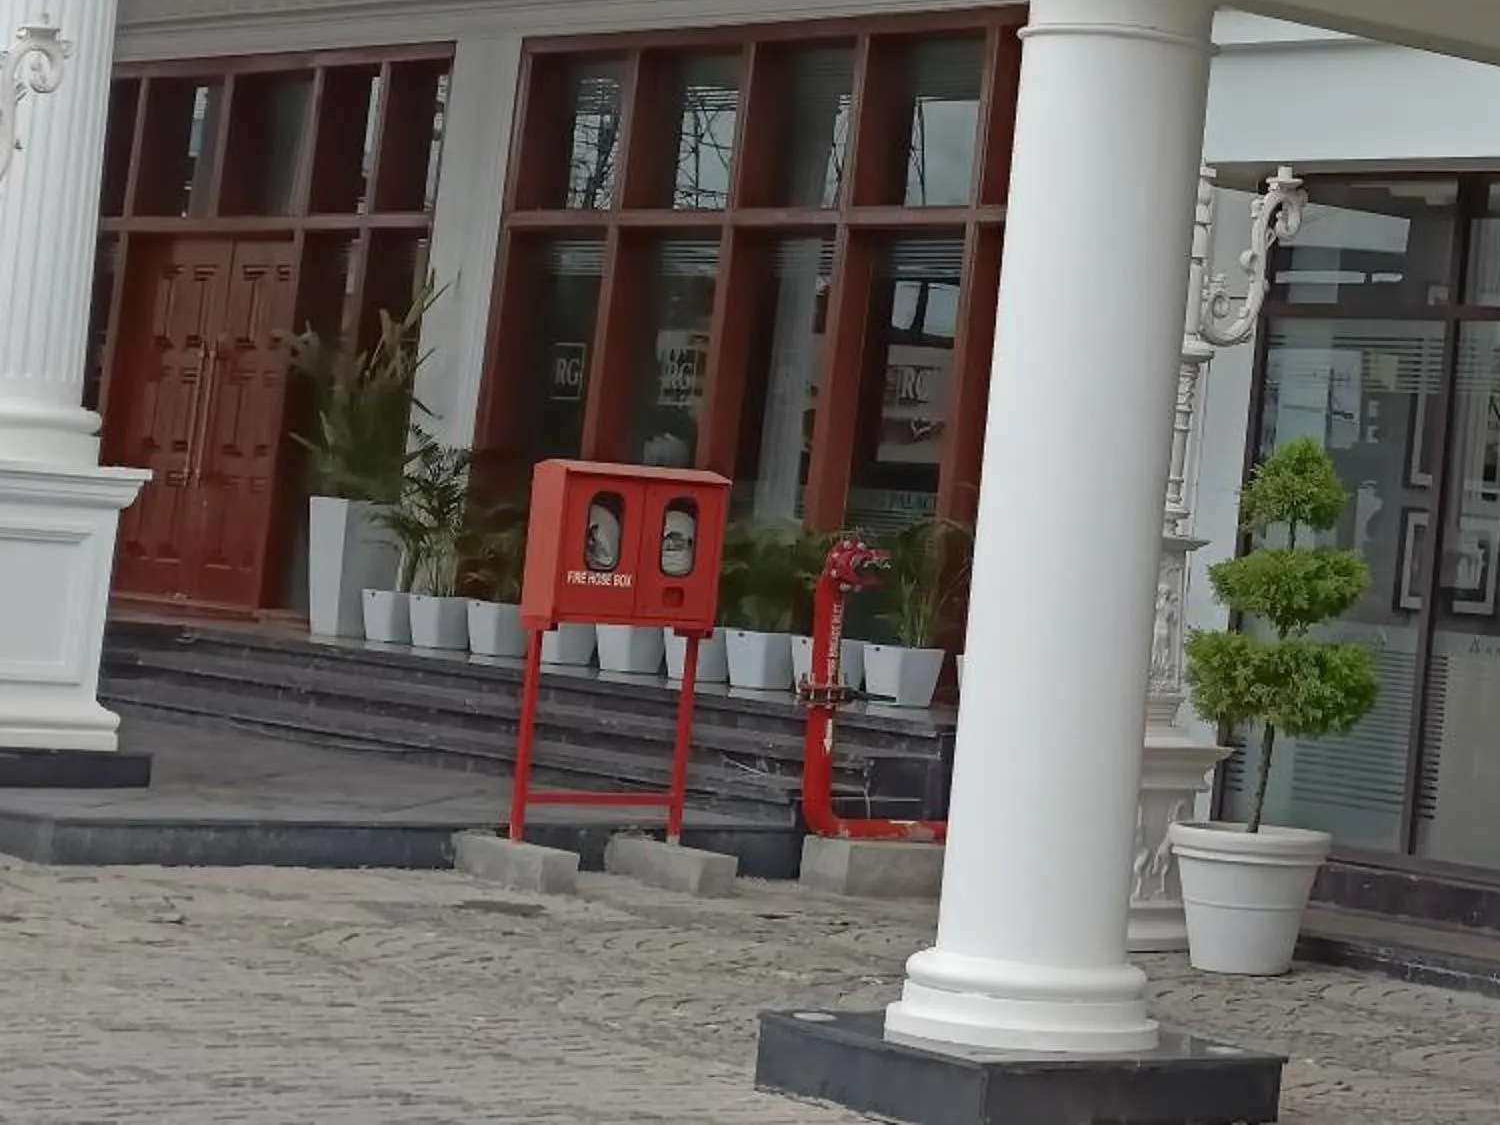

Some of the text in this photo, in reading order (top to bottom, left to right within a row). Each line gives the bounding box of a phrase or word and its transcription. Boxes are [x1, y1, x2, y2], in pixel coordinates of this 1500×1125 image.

[567, 570, 632, 588] FIRE HOSE BOX
